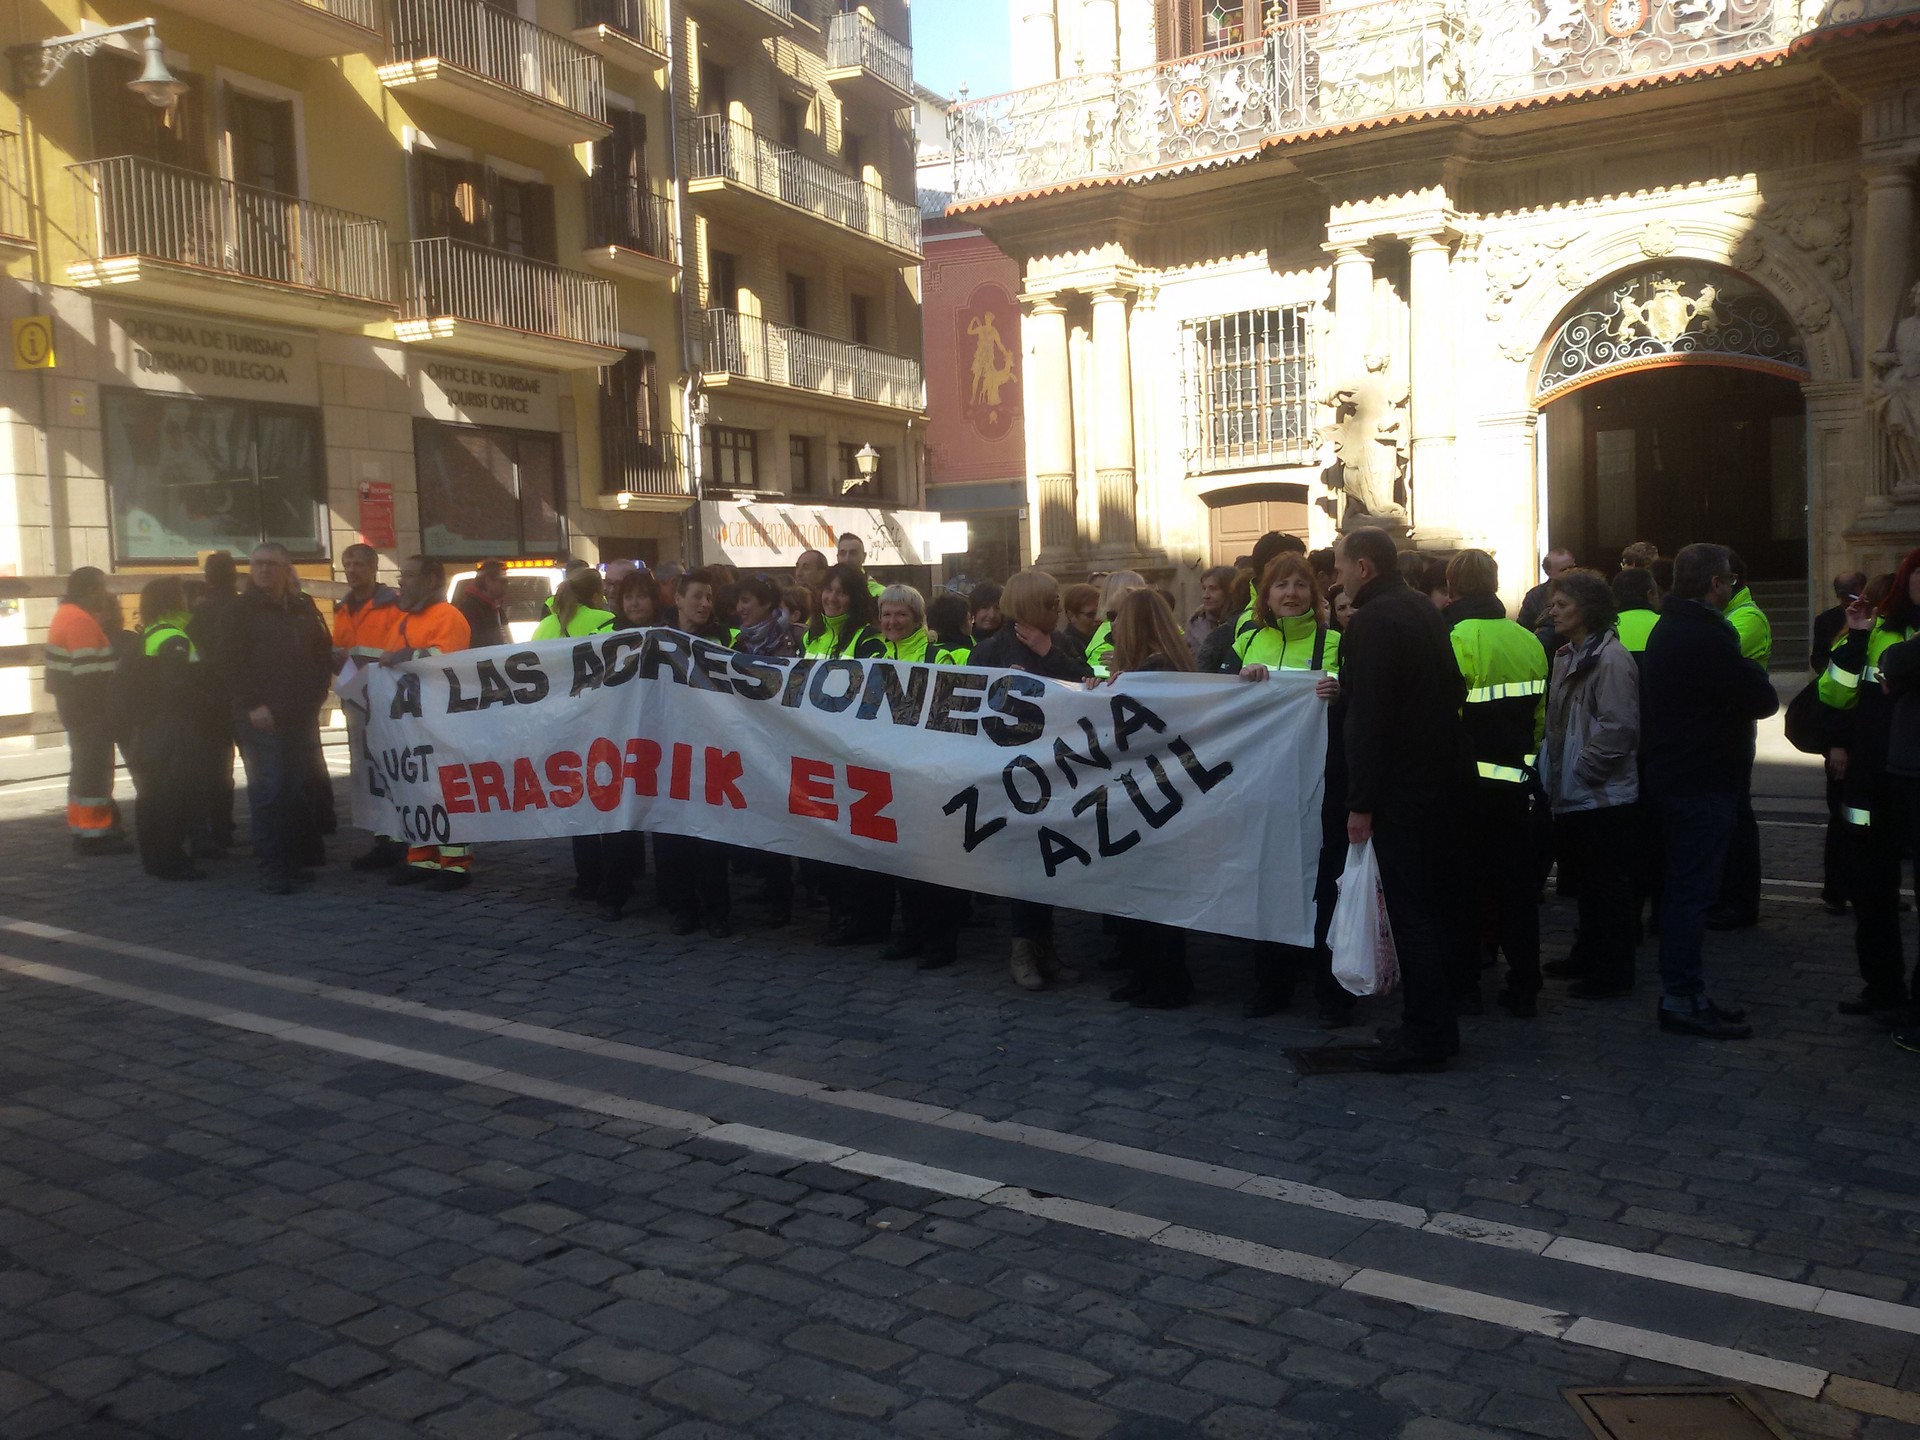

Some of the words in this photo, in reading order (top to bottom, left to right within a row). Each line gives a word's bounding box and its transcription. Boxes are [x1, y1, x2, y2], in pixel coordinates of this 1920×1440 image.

[123, 318, 197, 345] OFICINA
[202, 331, 224, 349] DE
[226, 334, 293, 358] TURISMO
[134, 348, 208, 375] TURISMO
[213, 357, 288, 384] BULEGOA
[427, 362, 470, 384] OFFICE
[472, 370, 488, 387] DE
[489, 374, 541, 395] TOURISME
[446, 389, 488, 409] TOURIST
[491, 394, 529, 414] OFFICE
[728, 516, 828, 548] carnedenavarra.com
[390, 673, 423, 720] A
[442, 650, 549, 714] LAS
[570, 627, 1046, 747] AGRESIONES
[383, 744, 434, 785] UGT
[942, 693, 1167, 853] ZONA
[438, 736, 748, 813] ERASORIK
[788, 756, 898, 844] EZ
[1038, 735, 1234, 878] AZUL
[396, 803, 451, 844] COO
